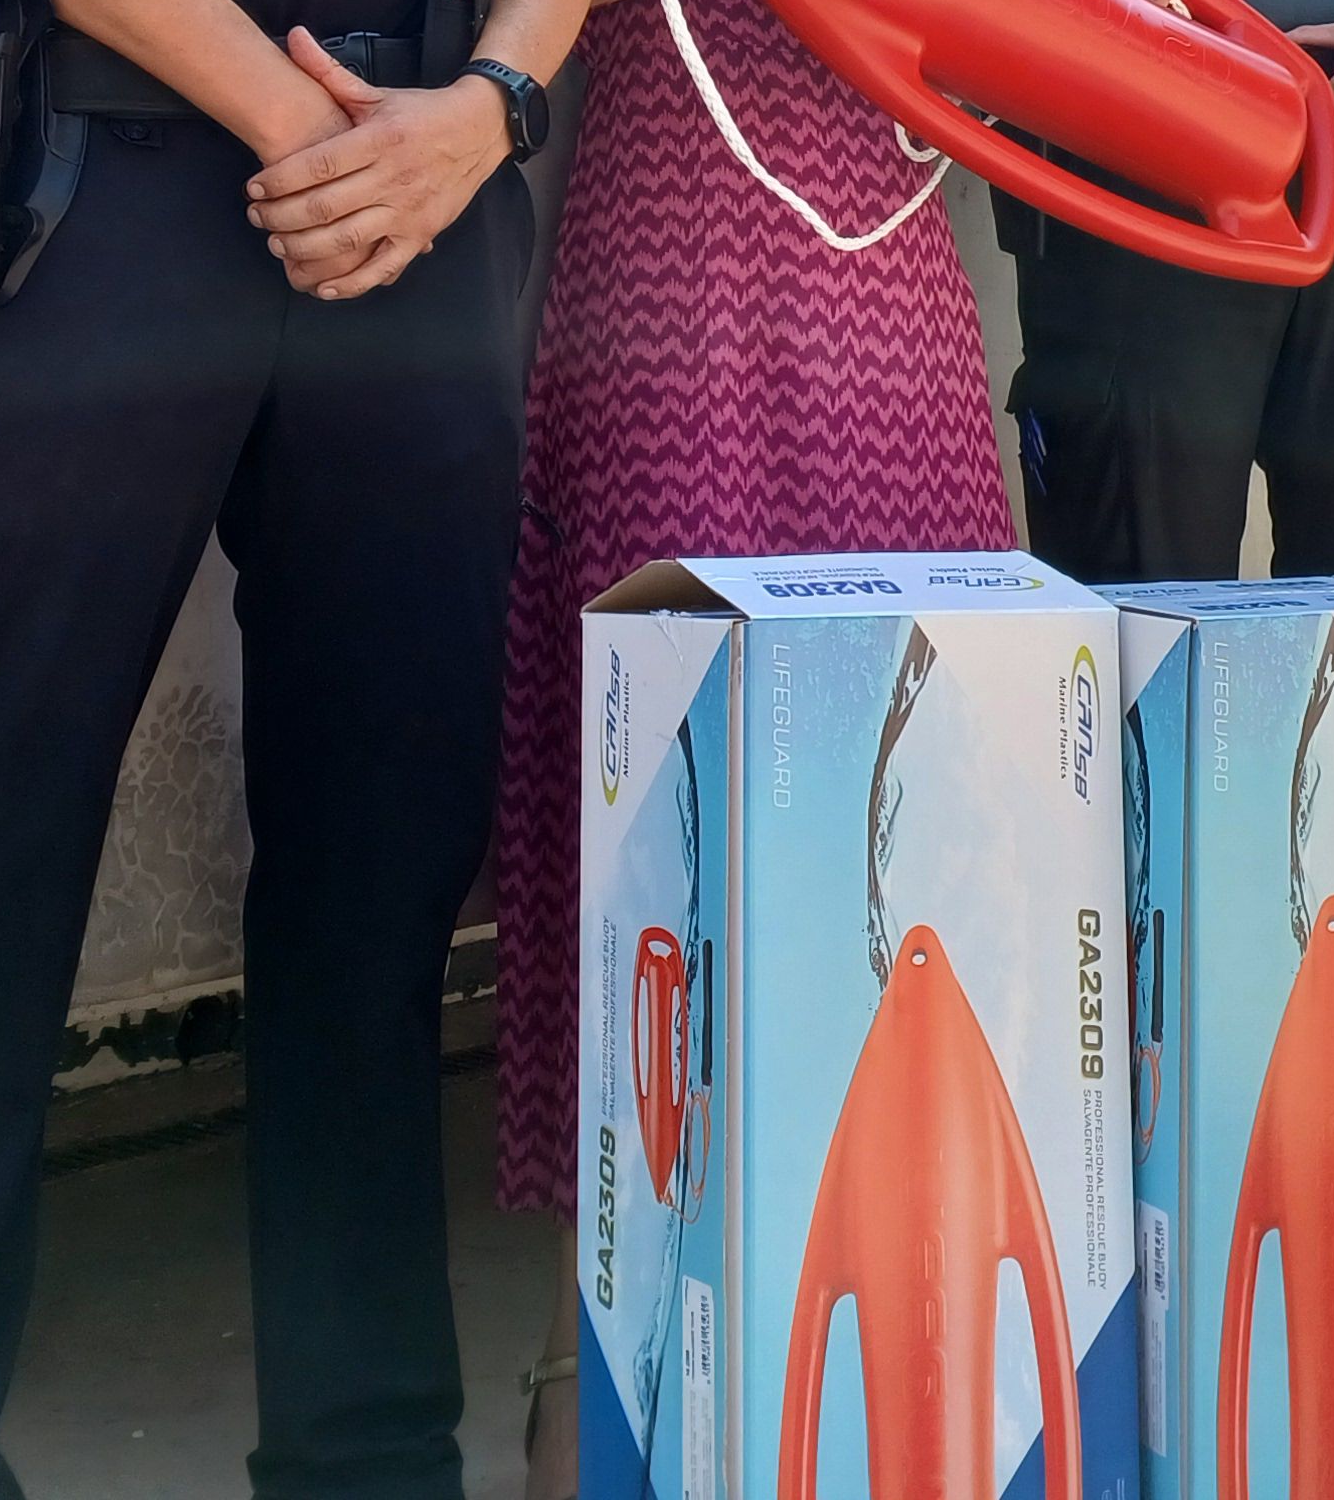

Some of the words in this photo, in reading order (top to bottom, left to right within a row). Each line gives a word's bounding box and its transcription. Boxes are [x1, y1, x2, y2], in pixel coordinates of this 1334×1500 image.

[762, 580, 903, 598] GA2309
[772, 642, 793, 809] LIFEGUARD
[1058, 676, 1067, 724] Marine
[1212, 641, 1229, 793] LIFEGUARD
[1059, 728, 1068, 780] Plastics
[609, 921, 617, 1033] PROFESSIONALE
[1077, 908, 1104, 1080] GA2309
[600, 1010, 609, 1117] PROFESSIONAL
[1083, 1088, 1093, 1172] SALVAGENTE
[1094, 1089, 1104, 1192] PROFESSIONAL
[597, 1124, 617, 1311] GA2309
[1085, 1174, 1096, 1288] PROFESSIONALE
[1097, 1195, 1105, 1251] RESCUE
